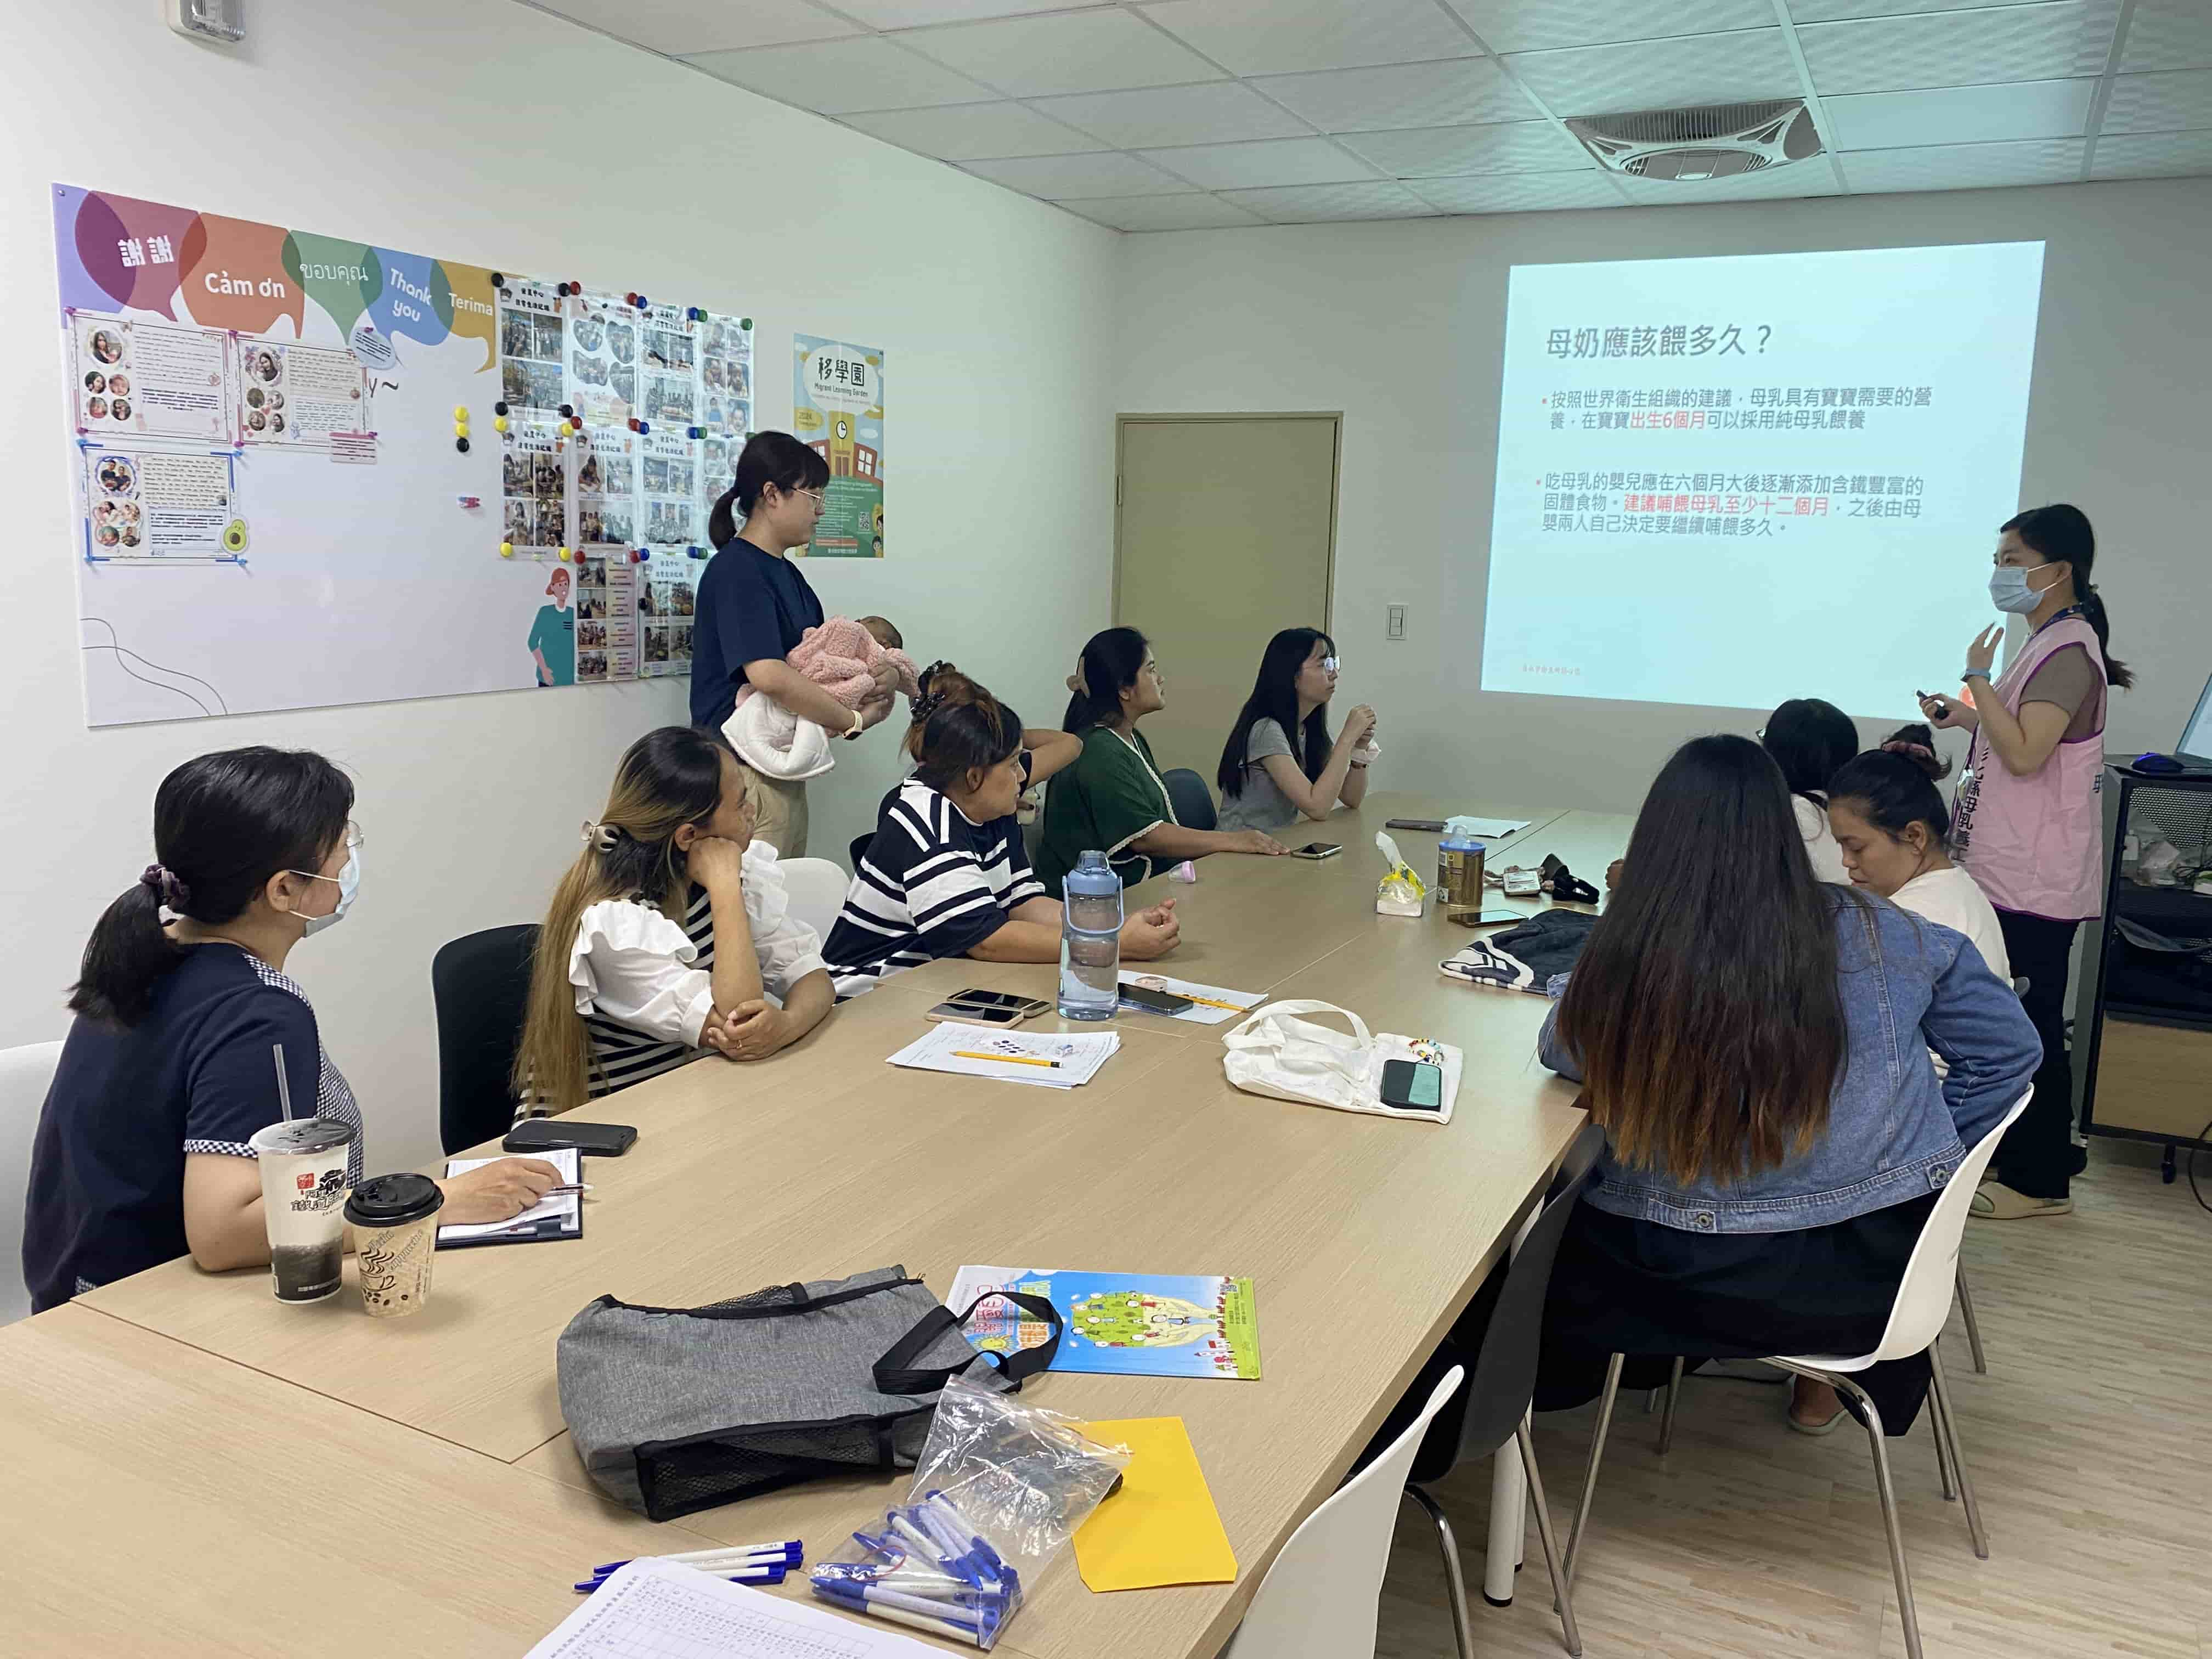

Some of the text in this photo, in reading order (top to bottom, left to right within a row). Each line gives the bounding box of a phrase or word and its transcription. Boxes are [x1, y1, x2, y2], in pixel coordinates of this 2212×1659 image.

[117, 234, 174, 267] 謝謝
[204, 271, 286, 299] Cảm ơn
[298, 261, 369, 291] ขอบคุณ
[389, 267, 432, 307] Thank
[392, 298, 421, 323] you
[448, 291, 494, 317] Terima
[1546, 324, 1772, 360] 母奶應該餵多久？
[817, 357, 865, 387] 移學園
[853, 388, 868, 397] Garden
[1545, 472, 1924, 496] 吃母乳的嬰兒應在六個月大後逐漸添加含鐵豐富的
